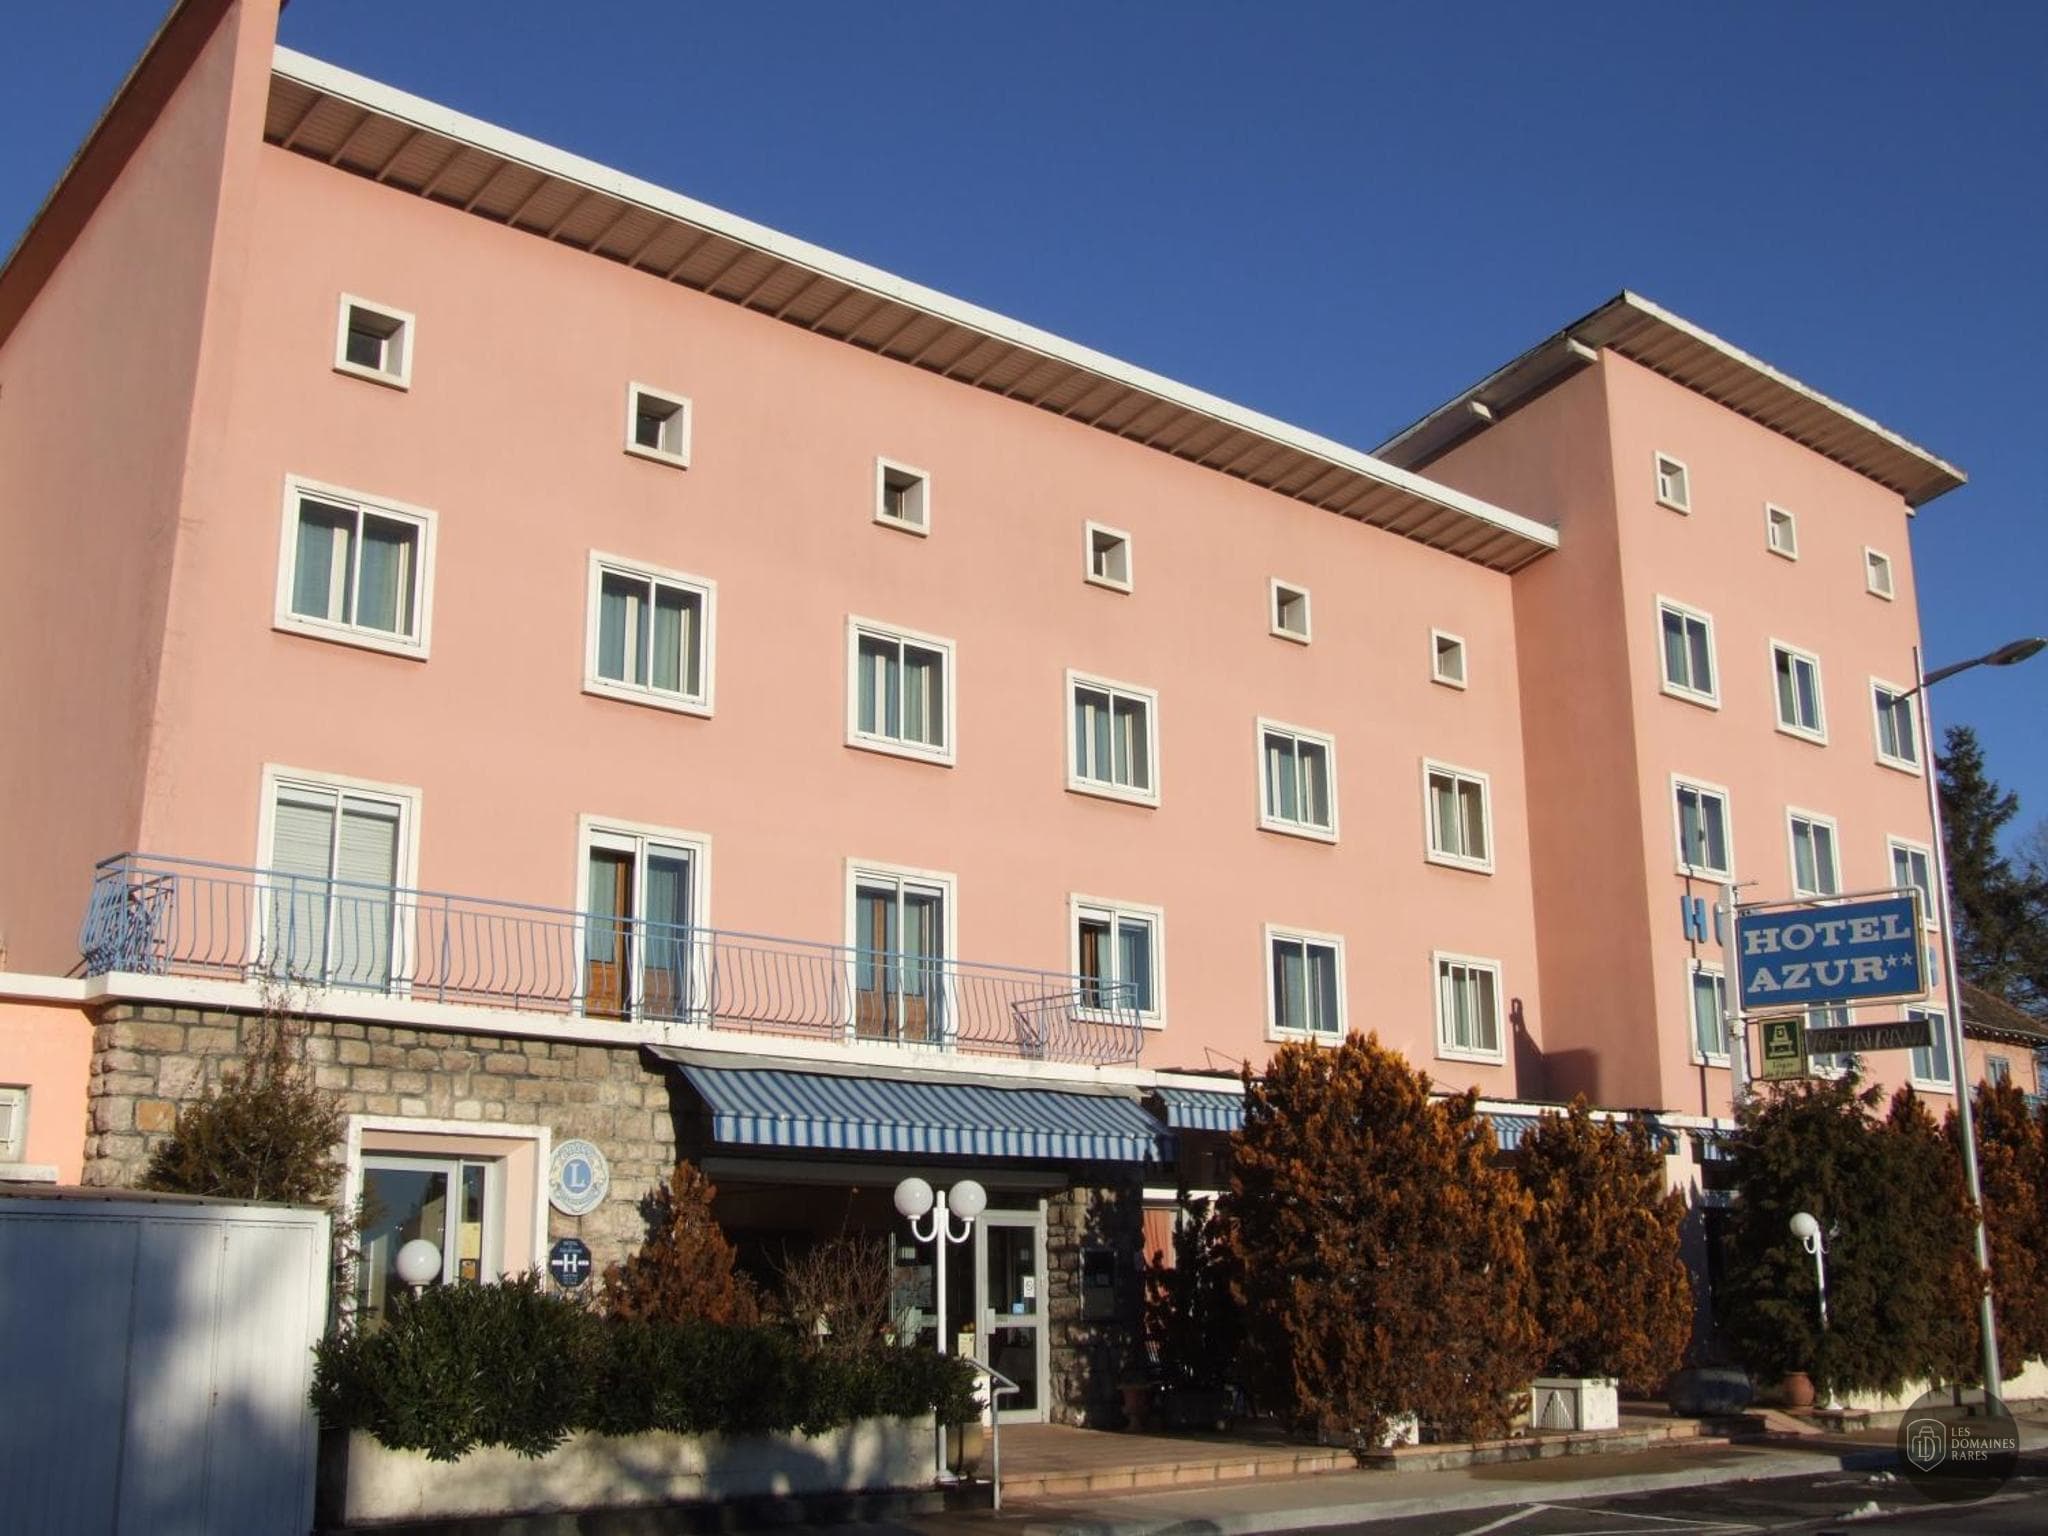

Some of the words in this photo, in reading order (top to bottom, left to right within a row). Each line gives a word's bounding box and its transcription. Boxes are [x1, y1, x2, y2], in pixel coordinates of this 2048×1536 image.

[1743, 914, 1911, 955] HOTEL
[1747, 956, 1888, 993] AZUR
[568, 1163, 587, 1188] L
[563, 1253, 578, 1273] H
